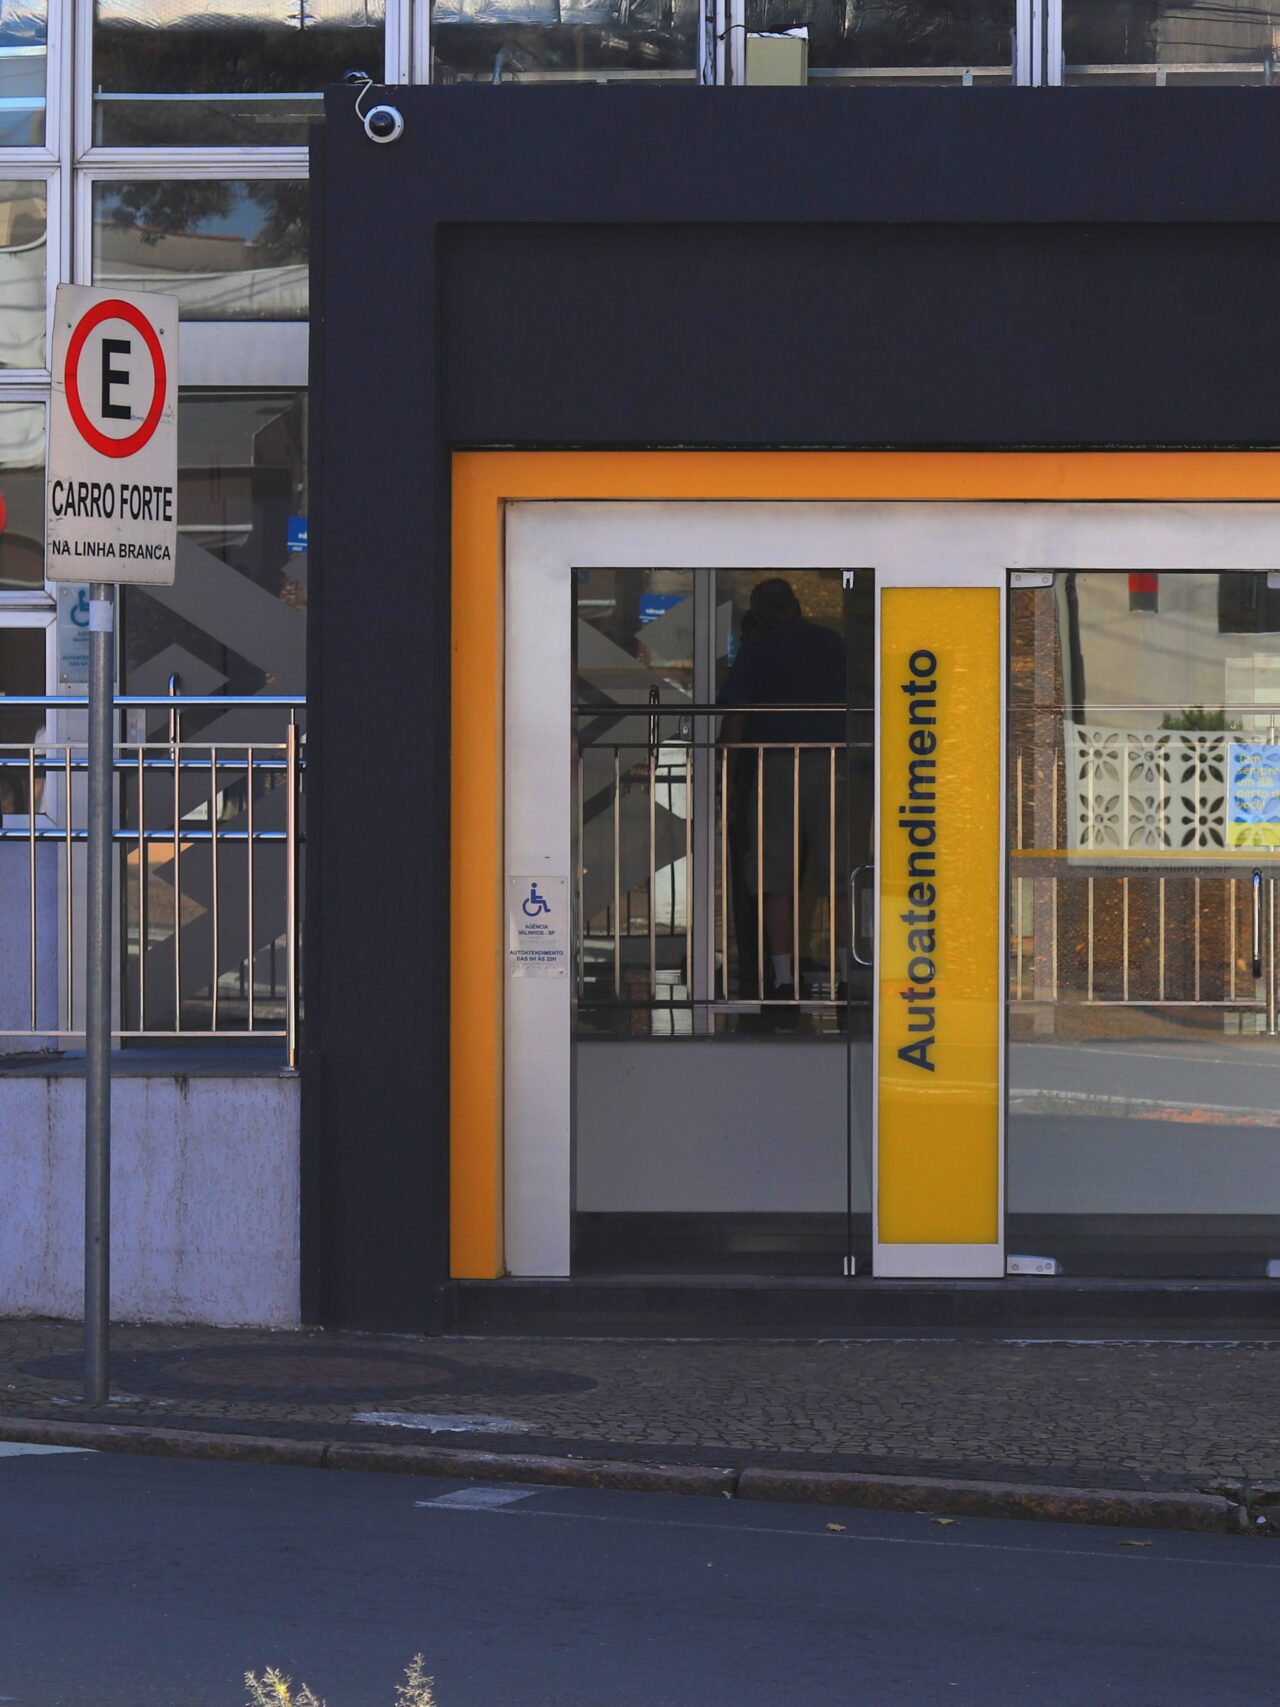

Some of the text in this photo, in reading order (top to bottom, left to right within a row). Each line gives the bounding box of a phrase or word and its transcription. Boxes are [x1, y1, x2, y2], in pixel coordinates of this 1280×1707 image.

[102, 338, 131, 420] E
[52, 480, 173, 522] CARRO FORTE
[52, 540, 171, 560] NA LINHA BRANCA
[897, 648, 938, 1073] Autoatendimento
